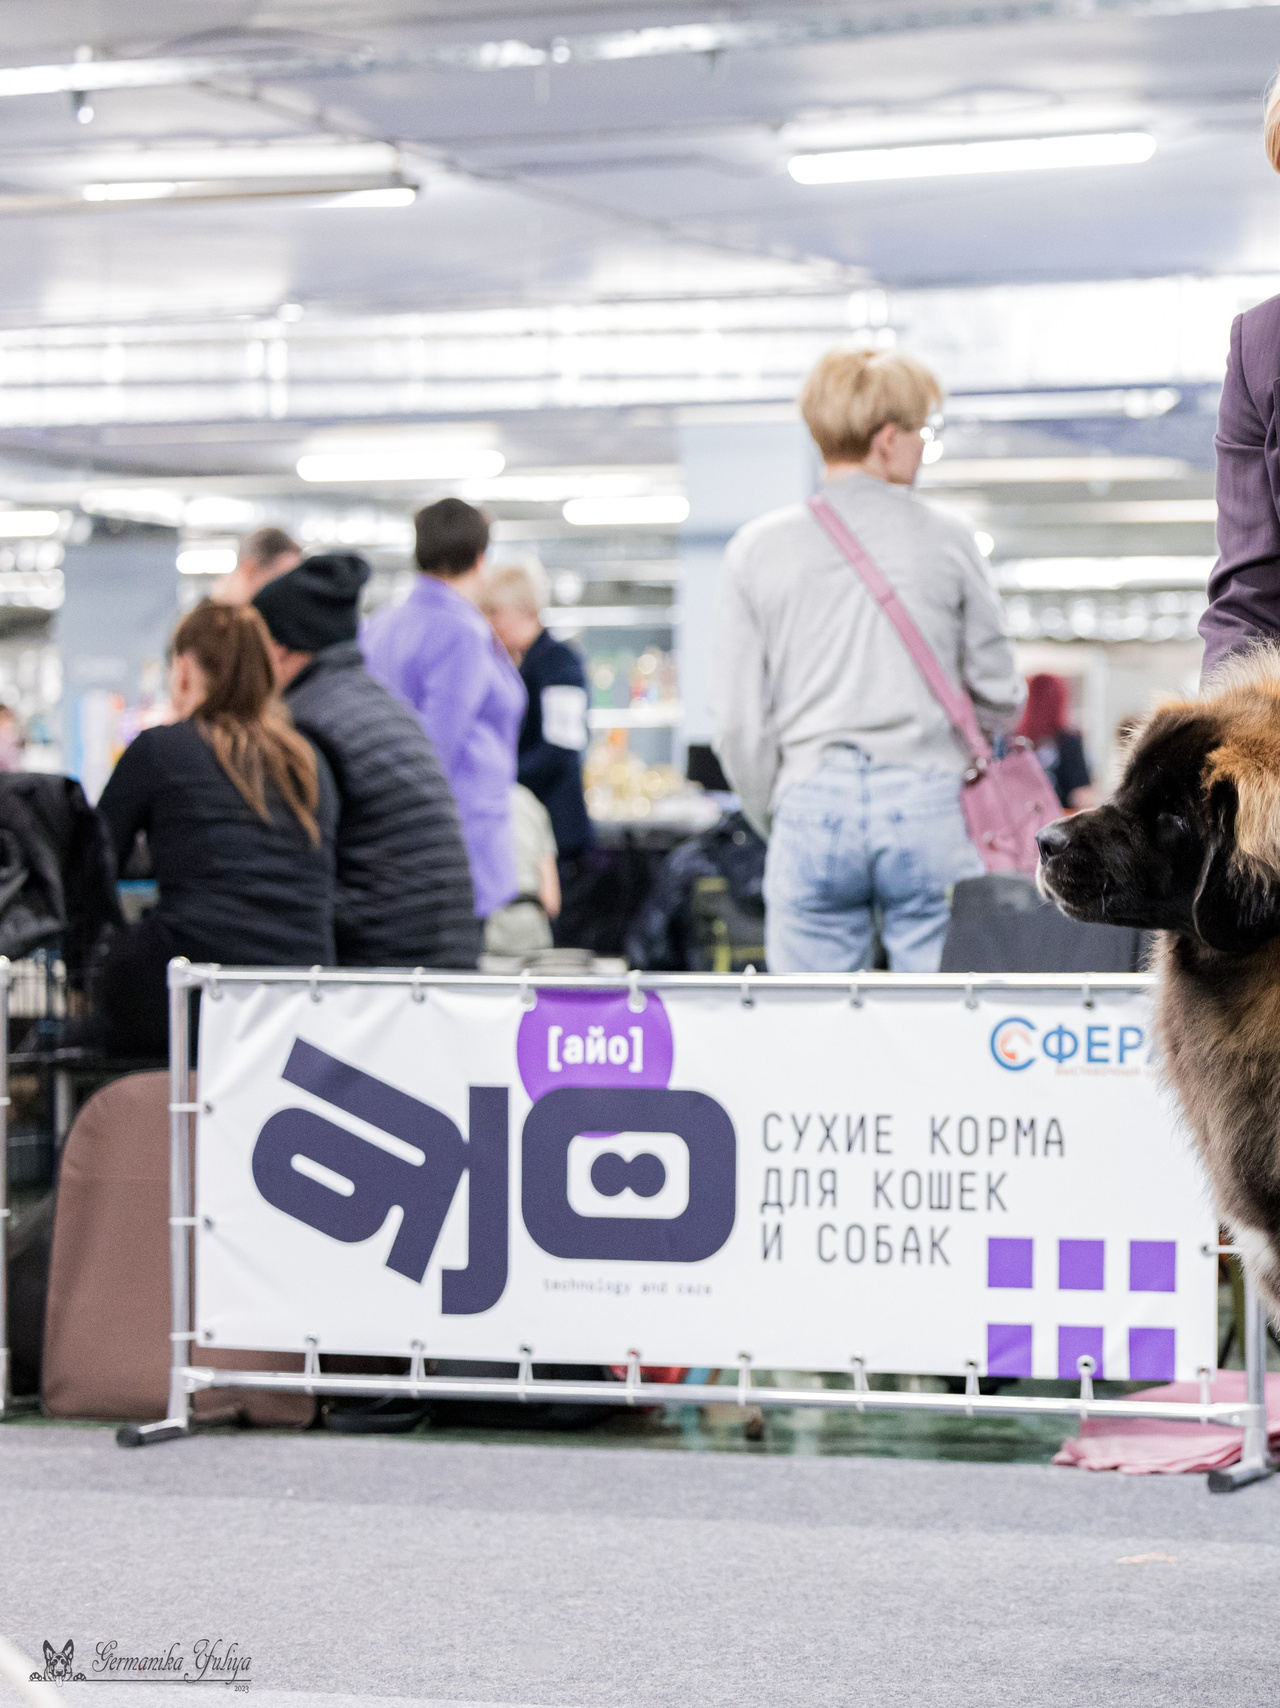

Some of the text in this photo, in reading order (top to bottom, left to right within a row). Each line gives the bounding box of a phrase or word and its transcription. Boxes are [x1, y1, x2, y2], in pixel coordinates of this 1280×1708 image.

[547, 1025, 644, 1074] [айо]
[762, 1112, 1065, 1158] СУХИЕ КОРМА
[760, 1167, 1008, 1215] ДЛЯ КОШЕК
[762, 1222, 951, 1266] И СОБАК
[543, 1278, 632, 1296] technology
[641, 1281, 669, 1295] and
